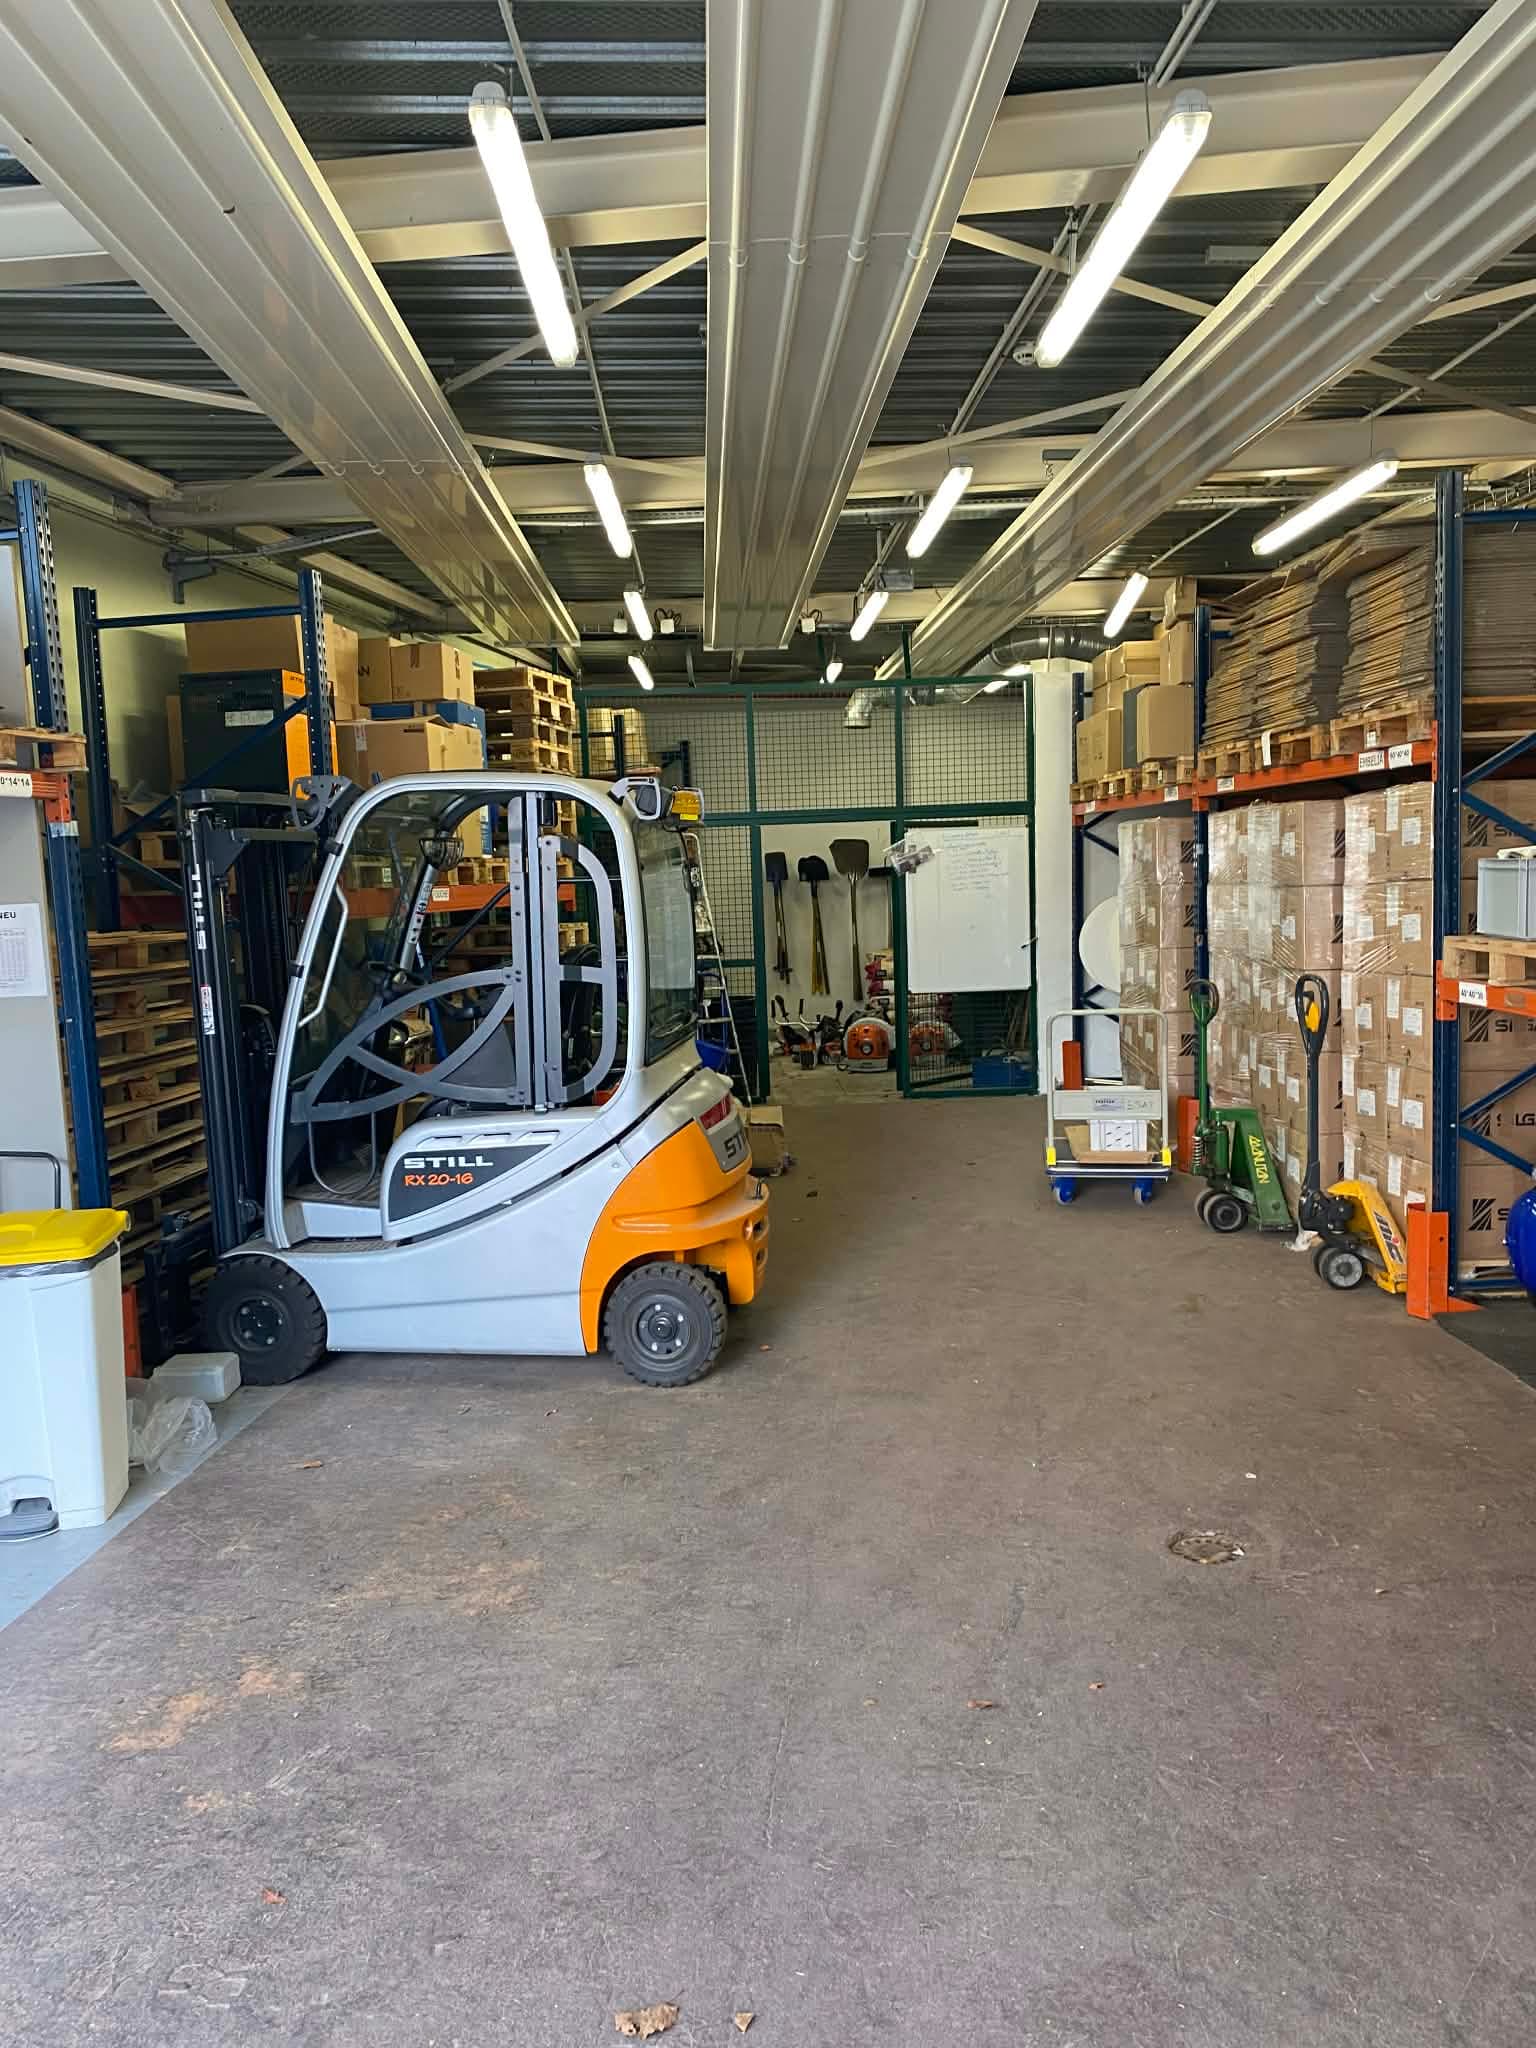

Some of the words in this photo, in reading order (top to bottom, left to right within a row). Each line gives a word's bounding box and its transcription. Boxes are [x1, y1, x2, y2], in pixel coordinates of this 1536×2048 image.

[191, 863, 207, 951] STILL
[404, 1156, 494, 1169] STILL
[405, 1175, 426, 1187] RX
[428, 1172, 474, 1186] 20-16
